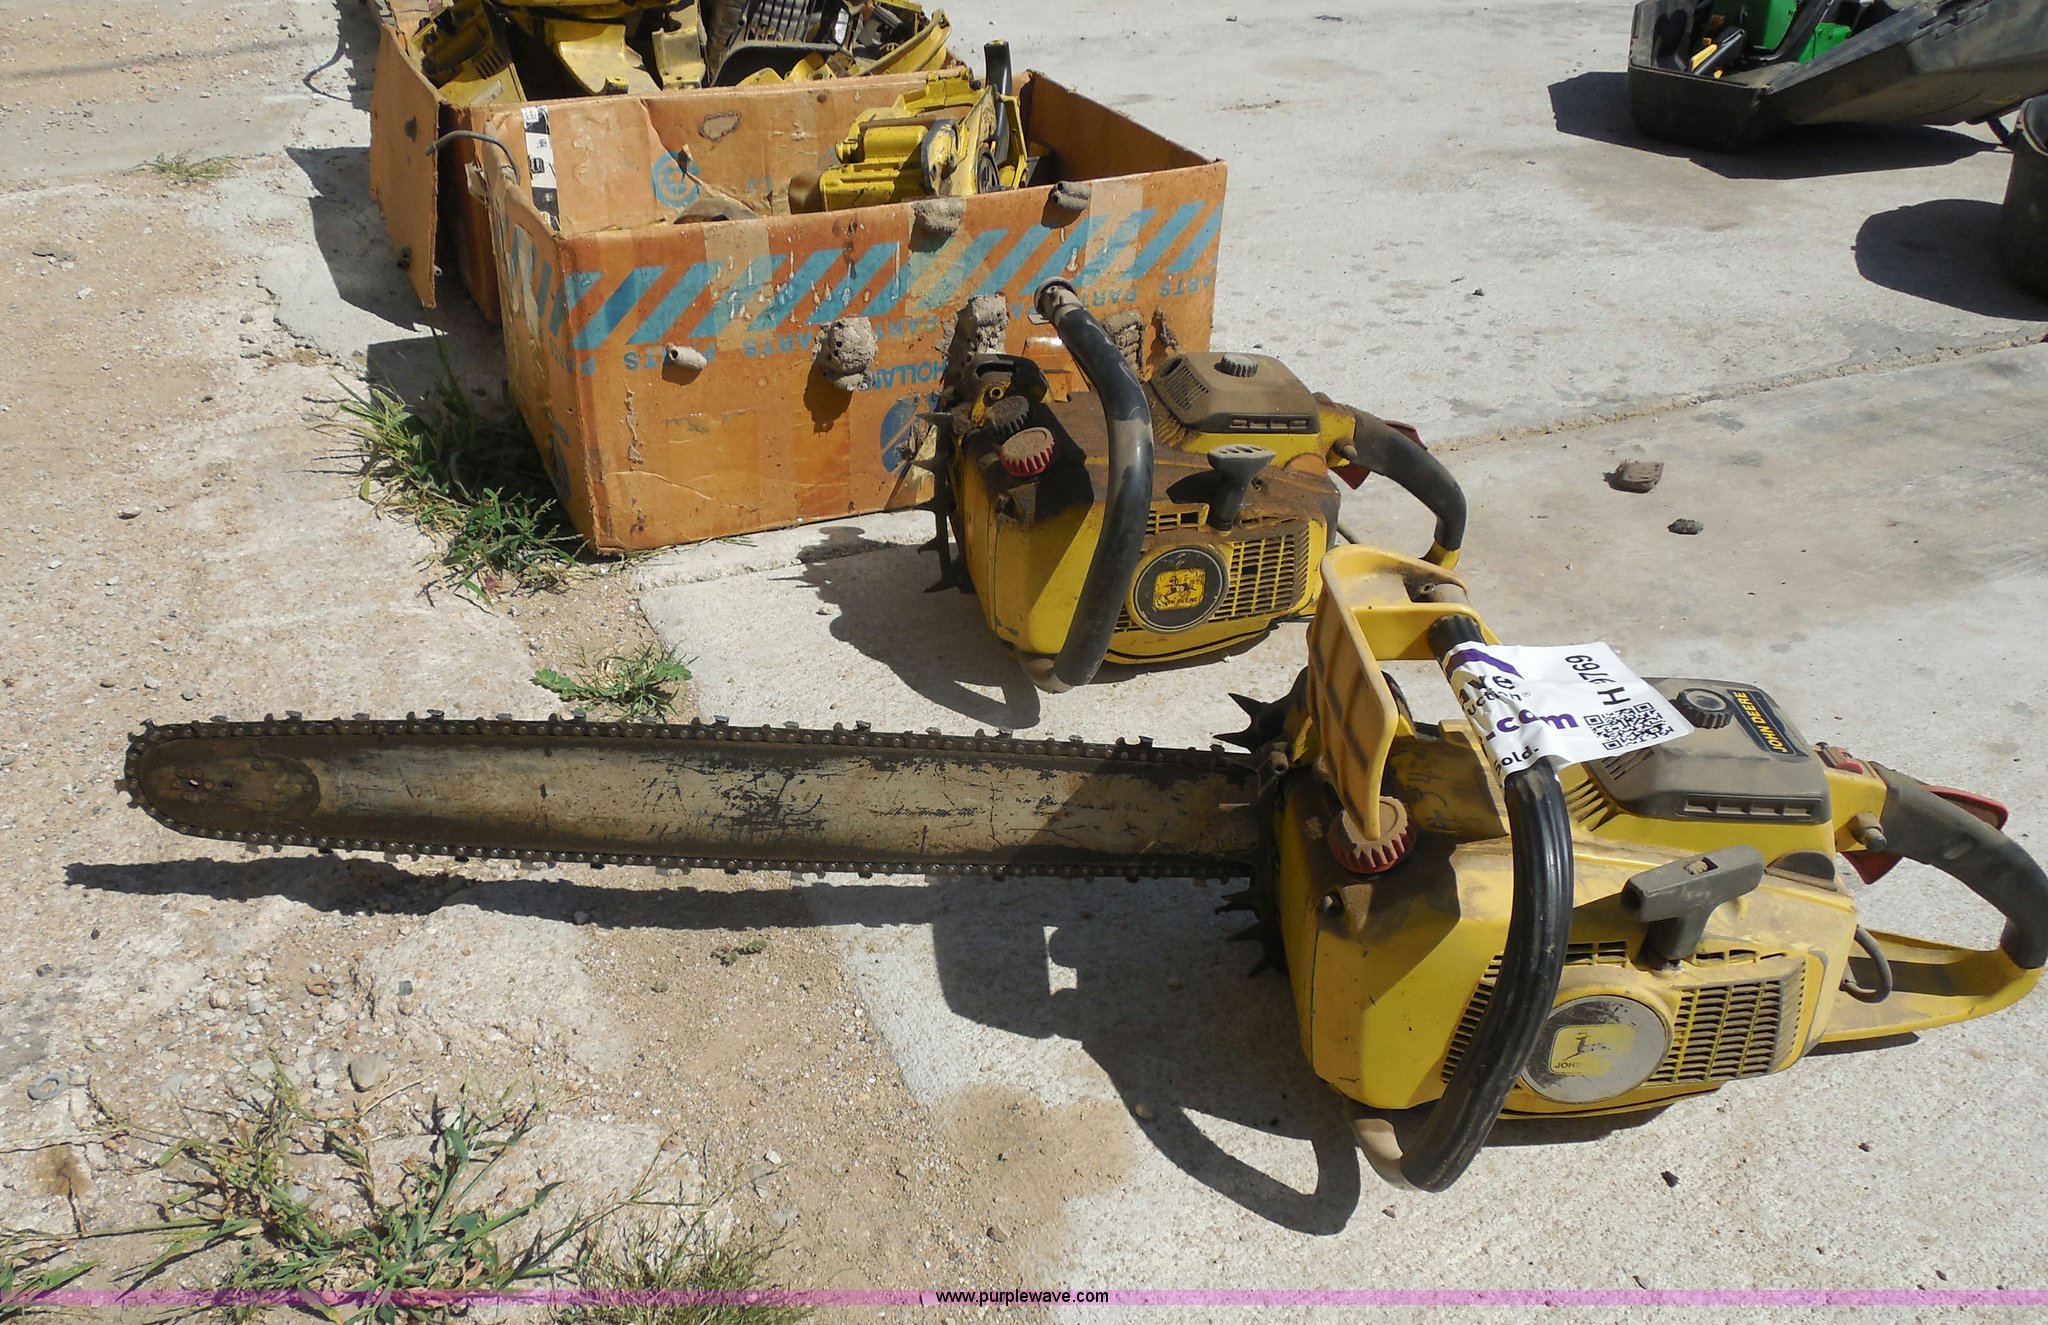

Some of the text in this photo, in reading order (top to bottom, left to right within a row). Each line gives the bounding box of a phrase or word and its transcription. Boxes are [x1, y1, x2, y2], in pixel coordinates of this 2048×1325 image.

[1079, 285, 1138, 309] PART
[1159, 273, 1213, 298] ARTS
[873, 316, 938, 341] PART
[741, 331, 813, 357] ARTS
[862, 360, 947, 392] HOLLAN
[1733, 691, 1788, 753] JOHN DEERE
